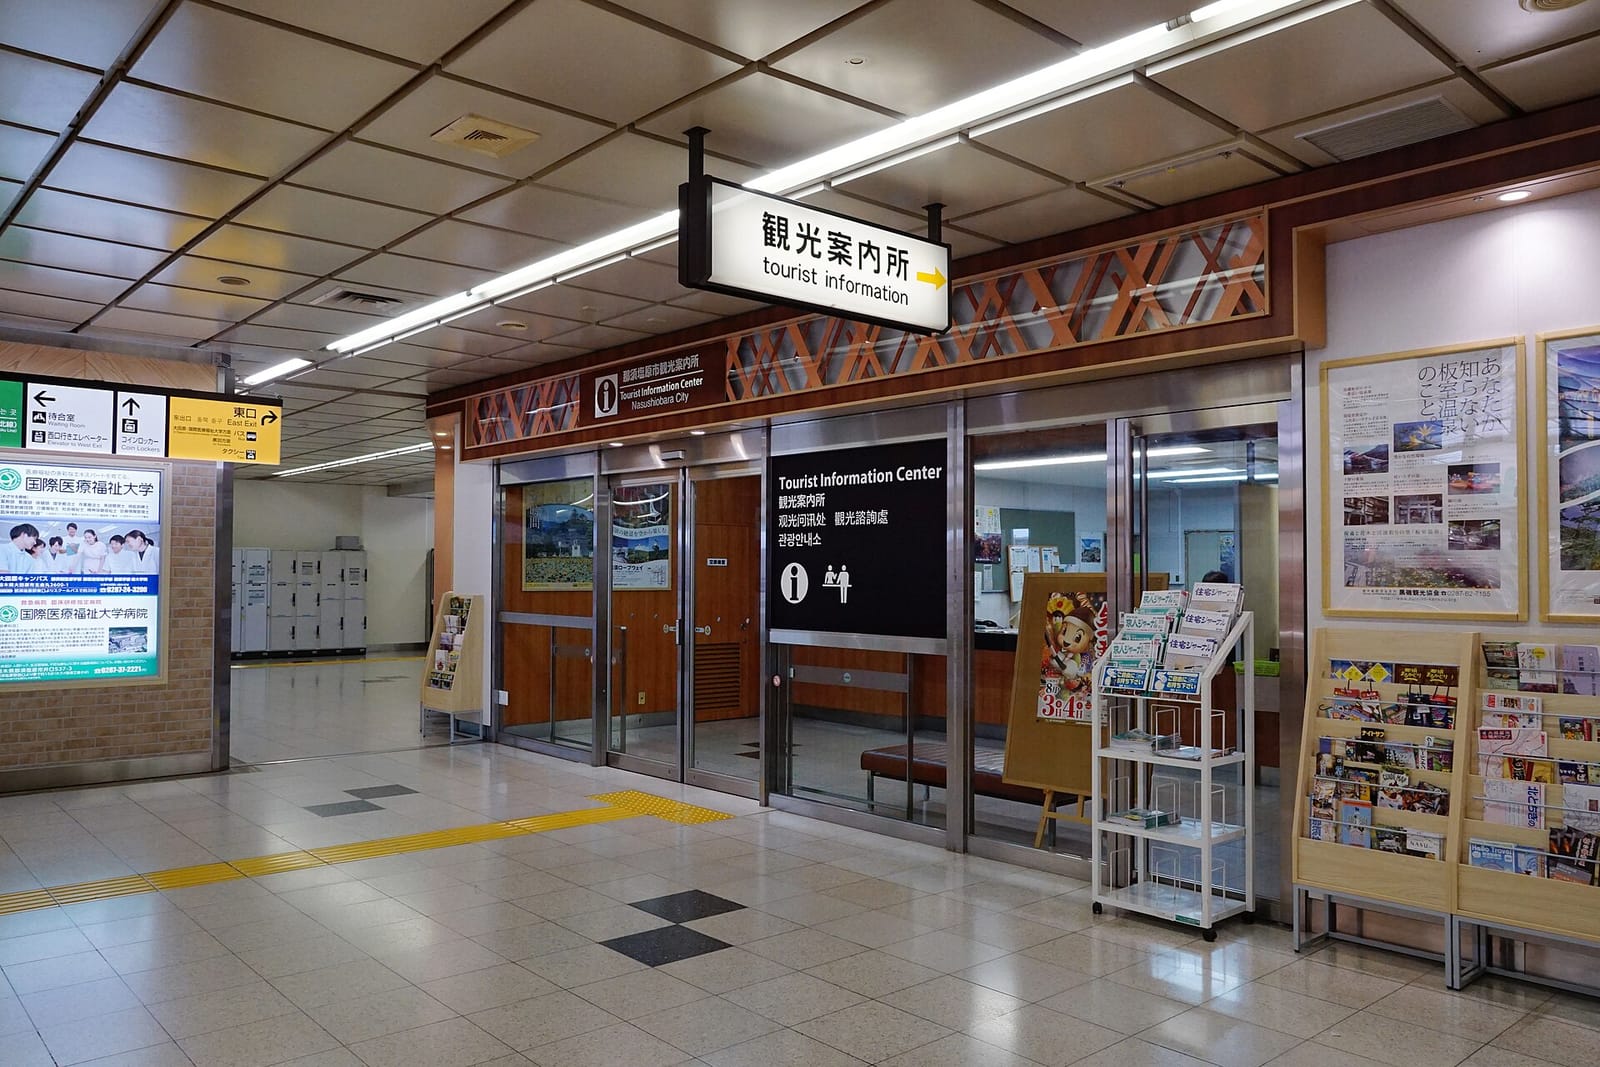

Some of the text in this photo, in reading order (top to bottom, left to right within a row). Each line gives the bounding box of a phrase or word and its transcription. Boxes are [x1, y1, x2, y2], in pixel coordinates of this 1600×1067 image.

[762, 211, 909, 281] 観光案内所
[764, 257, 908, 305] tourist information
[623, 354, 699, 382] 那須塩原市観光案内所
[620, 377, 704, 401] Tourist Information Center
[1418, 366, 1439, 424] のこと。
[1438, 361, 1458, 436] 板室温泉
[1459, 360, 1480, 432] 知らない
[1480, 357, 1502, 433] あなたが
[632, 392, 689, 411] Nasushiobara City
[48, 412, 75, 422] 待合室
[233, 407, 257, 419] 東口
[227, 420, 242, 428] East
[47, 431, 108, 443] 西口行きエレベーター
[121, 436, 159, 446] コインロッカー
[25, 476, 154, 497] 国際医療福祉大学
[778, 465, 943, 491] Tourist Information Center
[778, 493, 825, 510] 観光案内所
[778, 509, 889, 528] 观光问讯处 觀光諮詢處
[778, 532, 822, 548] 관광안내소
[1399, 589, 1439, 597] 黒磯観光協会
[20, 608, 149, 621] 国際医療福祉大学病院
[1185, 614, 1225, 626] 住宅ジャーナル
[1169, 639, 1212, 652] 住宅ジャーナル
[1527, 785, 1539, 828] 北とちぎの
[1471, 844, 1512, 855] Hello Travel
